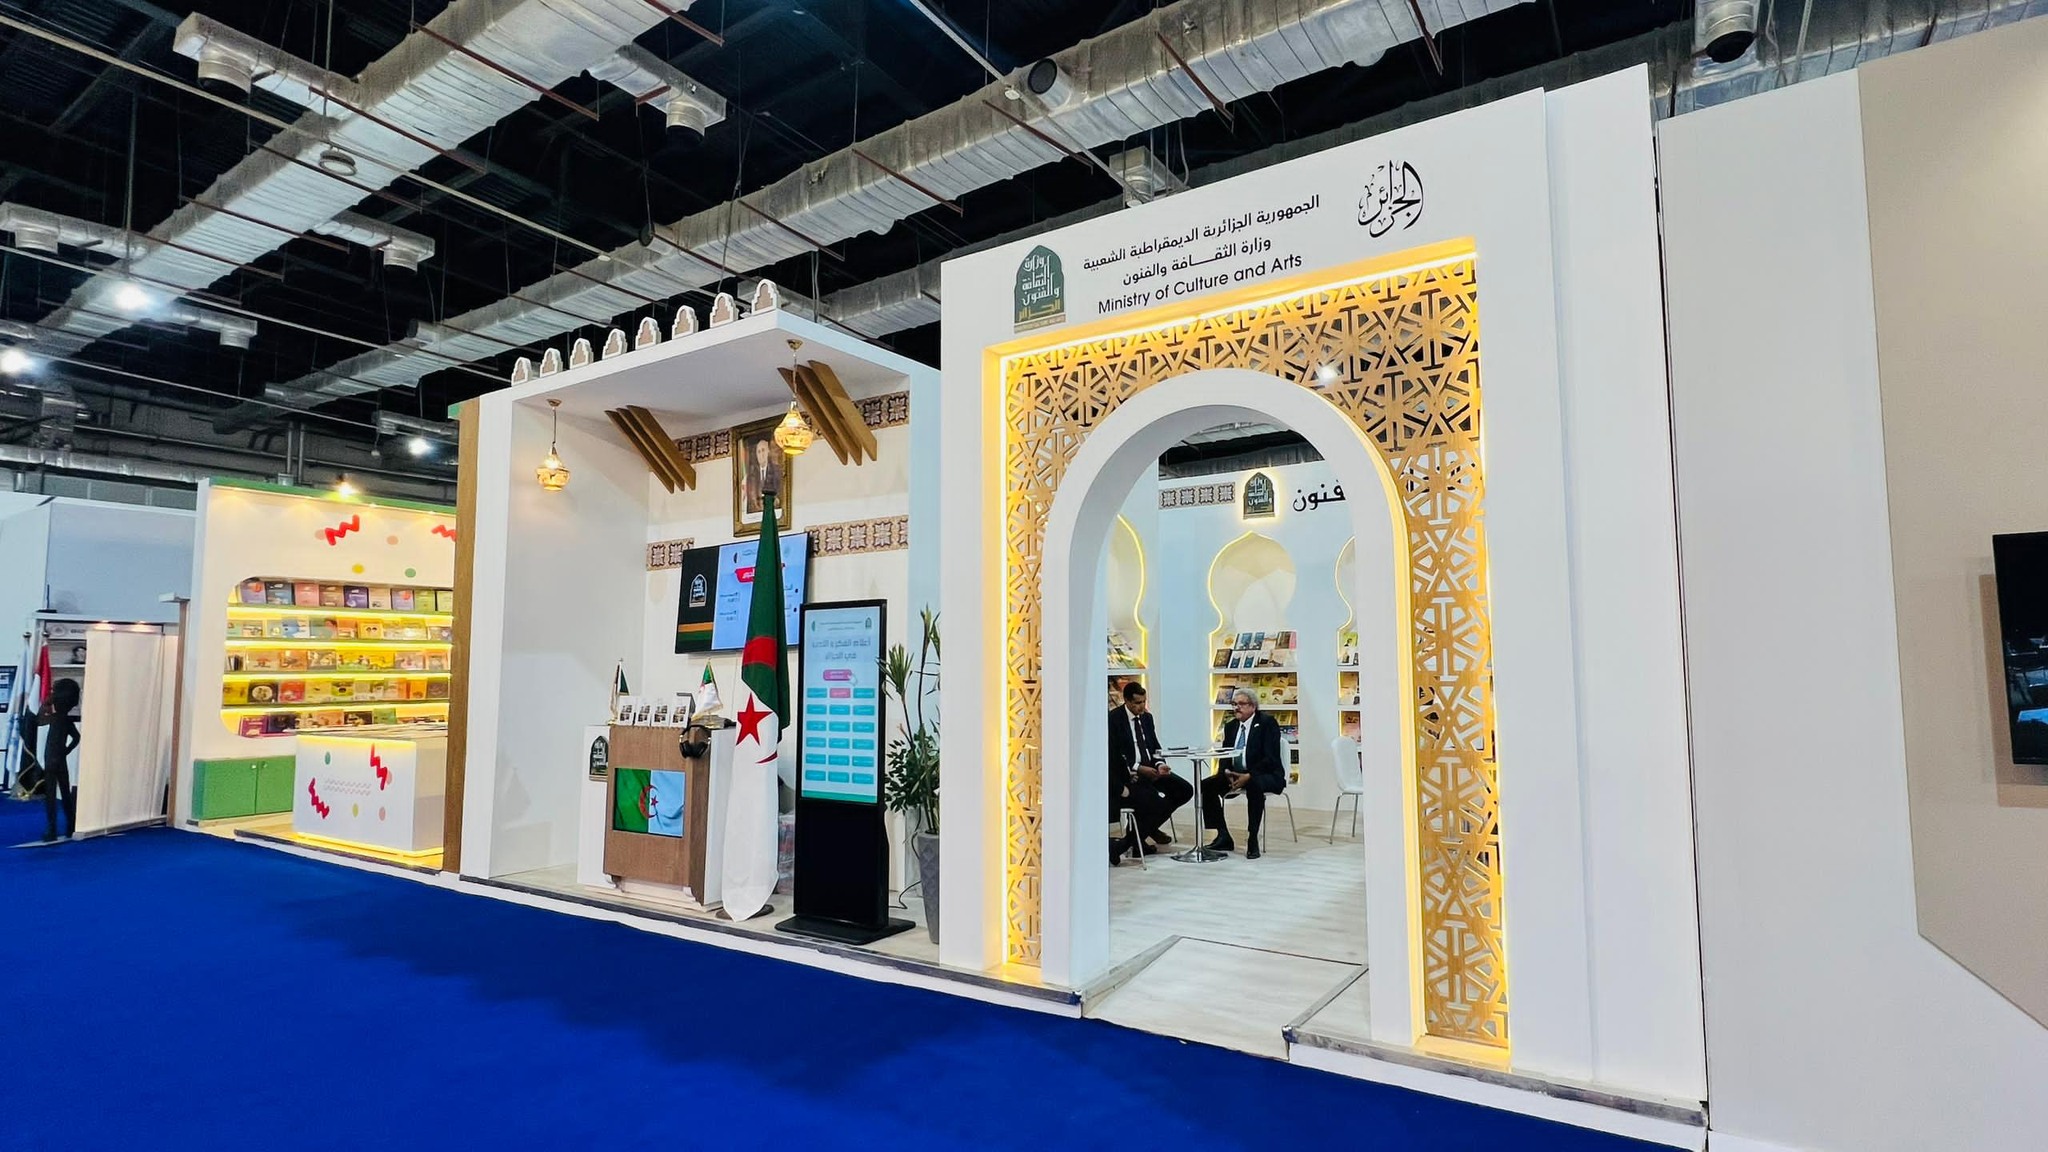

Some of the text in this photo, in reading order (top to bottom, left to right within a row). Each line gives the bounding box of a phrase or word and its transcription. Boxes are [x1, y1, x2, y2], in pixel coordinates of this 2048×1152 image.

[1256, 194, 1319, 225] الجمهورية
[1203, 212, 1252, 239] الجزائرية
[1241, 237, 1271, 255] وزارة
[1083, 248, 1126, 272] الشعبية
[1098, 253, 1302, 314] Ministry of Culture and Arts
[1123, 262, 1167, 286] والفنون
